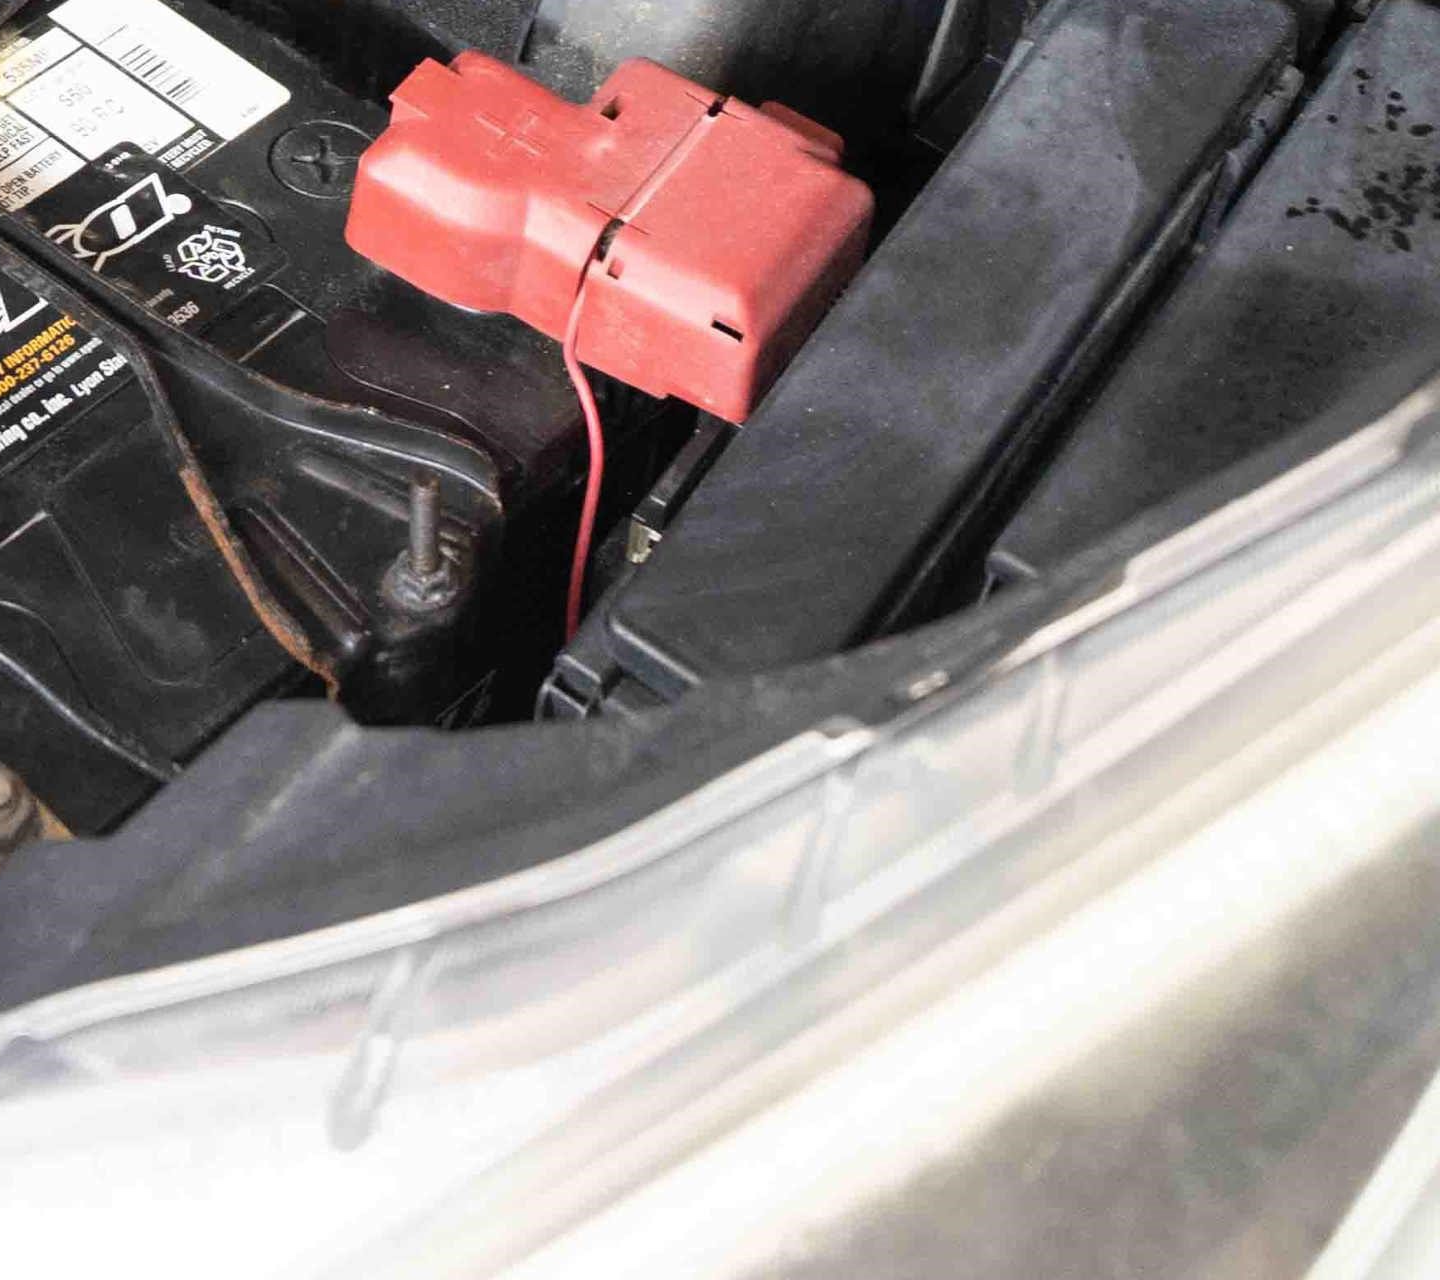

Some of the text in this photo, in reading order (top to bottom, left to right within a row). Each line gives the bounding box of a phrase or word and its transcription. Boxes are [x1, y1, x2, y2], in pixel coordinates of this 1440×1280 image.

[8, 129, 37, 151] FAST
[22, 149, 64, 178] BATTERY
[68, 367, 108, 399] Lyon
